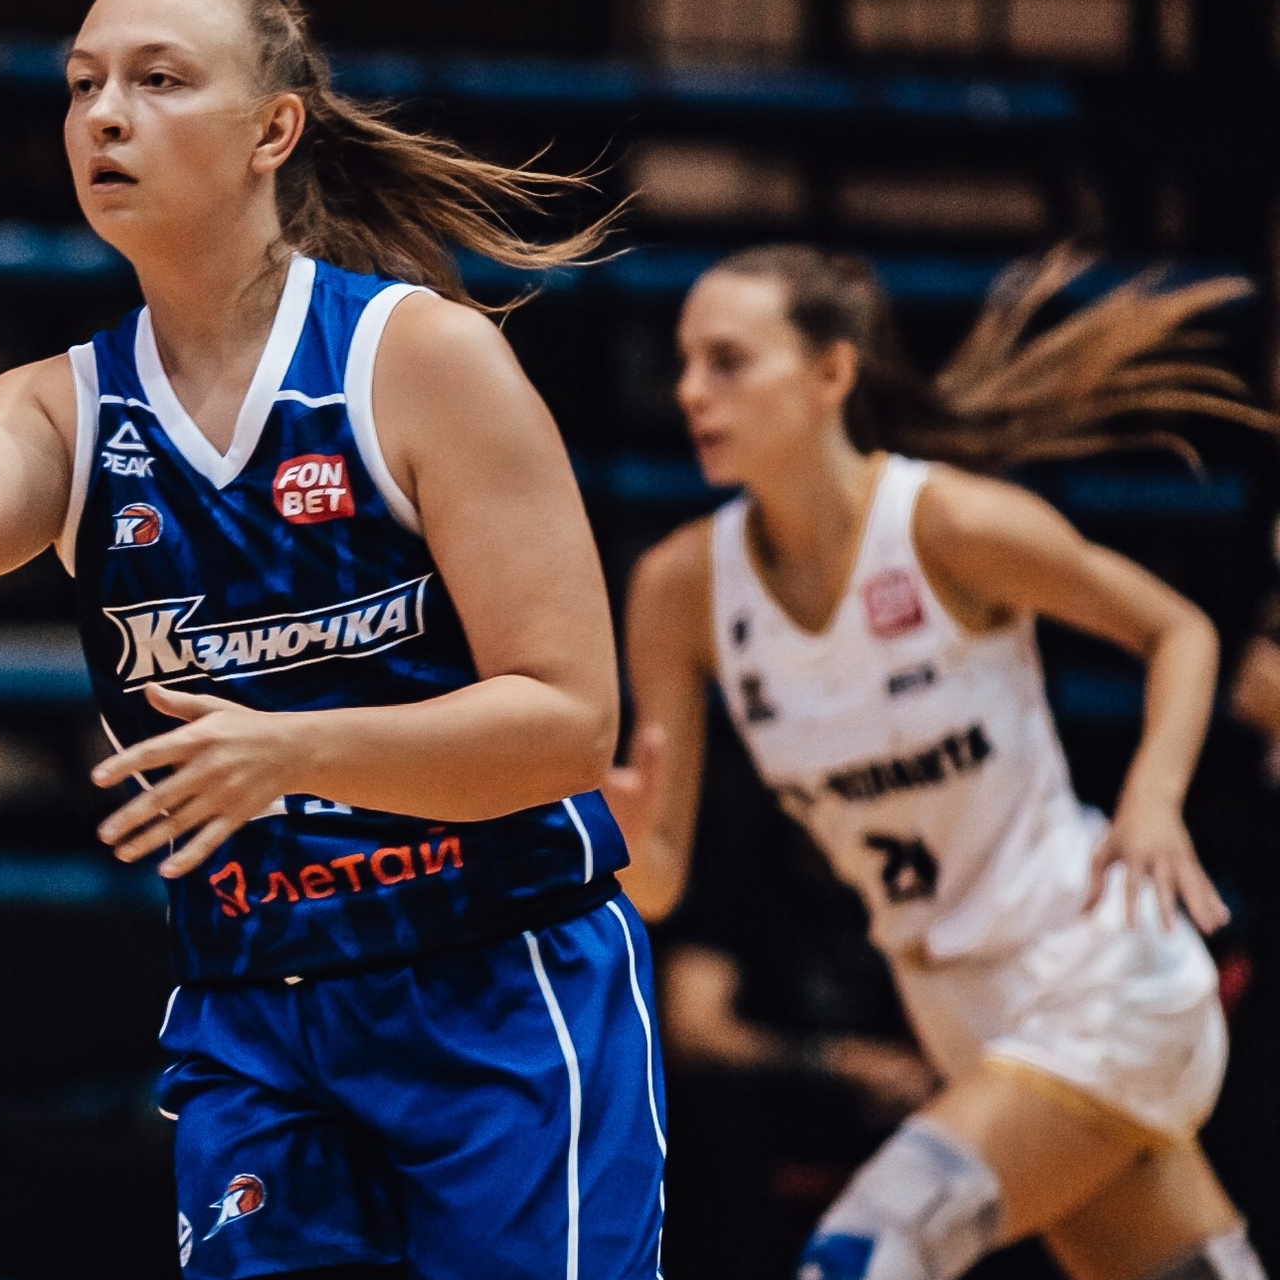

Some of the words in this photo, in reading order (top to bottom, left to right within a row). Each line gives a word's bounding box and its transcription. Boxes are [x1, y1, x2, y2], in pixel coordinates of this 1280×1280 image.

[101, 451, 156, 478] PEAK
[277, 461, 343, 490] FON
[282, 487, 347, 517] BET
[260, 826, 464, 903] летай
